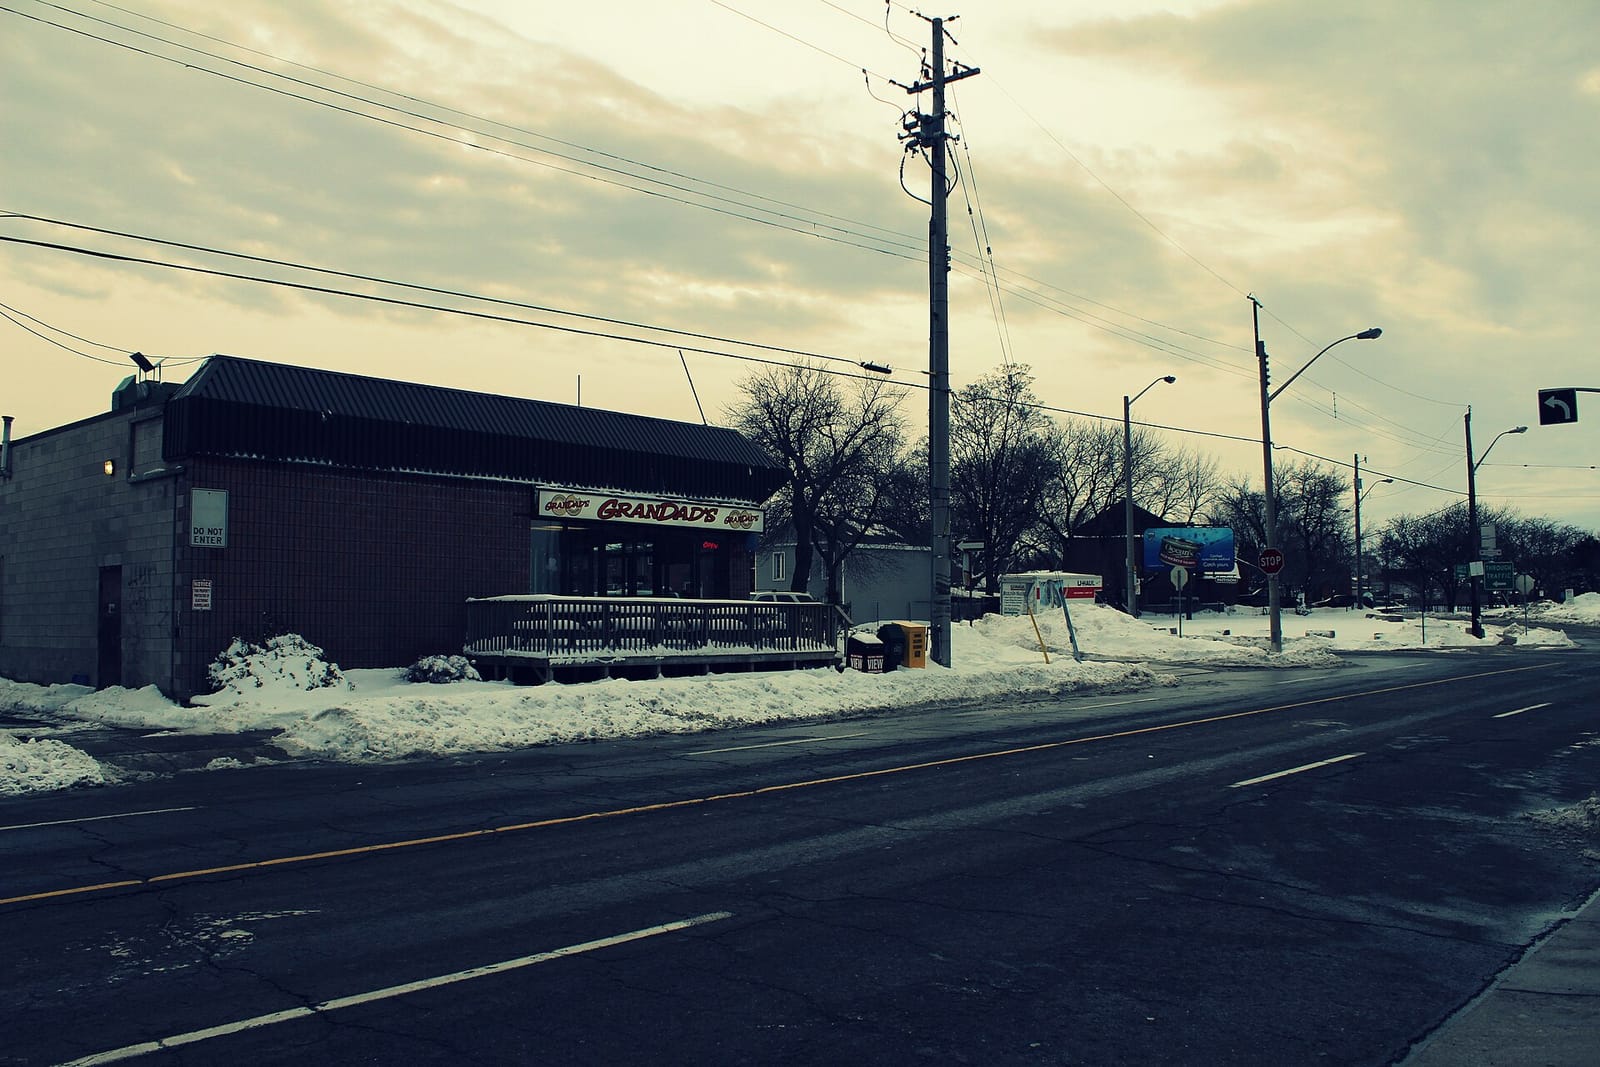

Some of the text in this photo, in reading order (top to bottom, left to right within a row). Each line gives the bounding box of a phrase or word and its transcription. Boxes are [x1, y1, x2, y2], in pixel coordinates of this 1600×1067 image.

[596, 499, 718, 523] GRANDAD'S
[193, 527, 223, 536] DO NOT
[193, 535, 222, 545] ENTER
[1260, 555, 1282, 567] STOP
[1485, 564, 1512, 572] THROUGH
[850, 657, 863, 669] VIEW
[867, 658, 884, 670] VIEW
